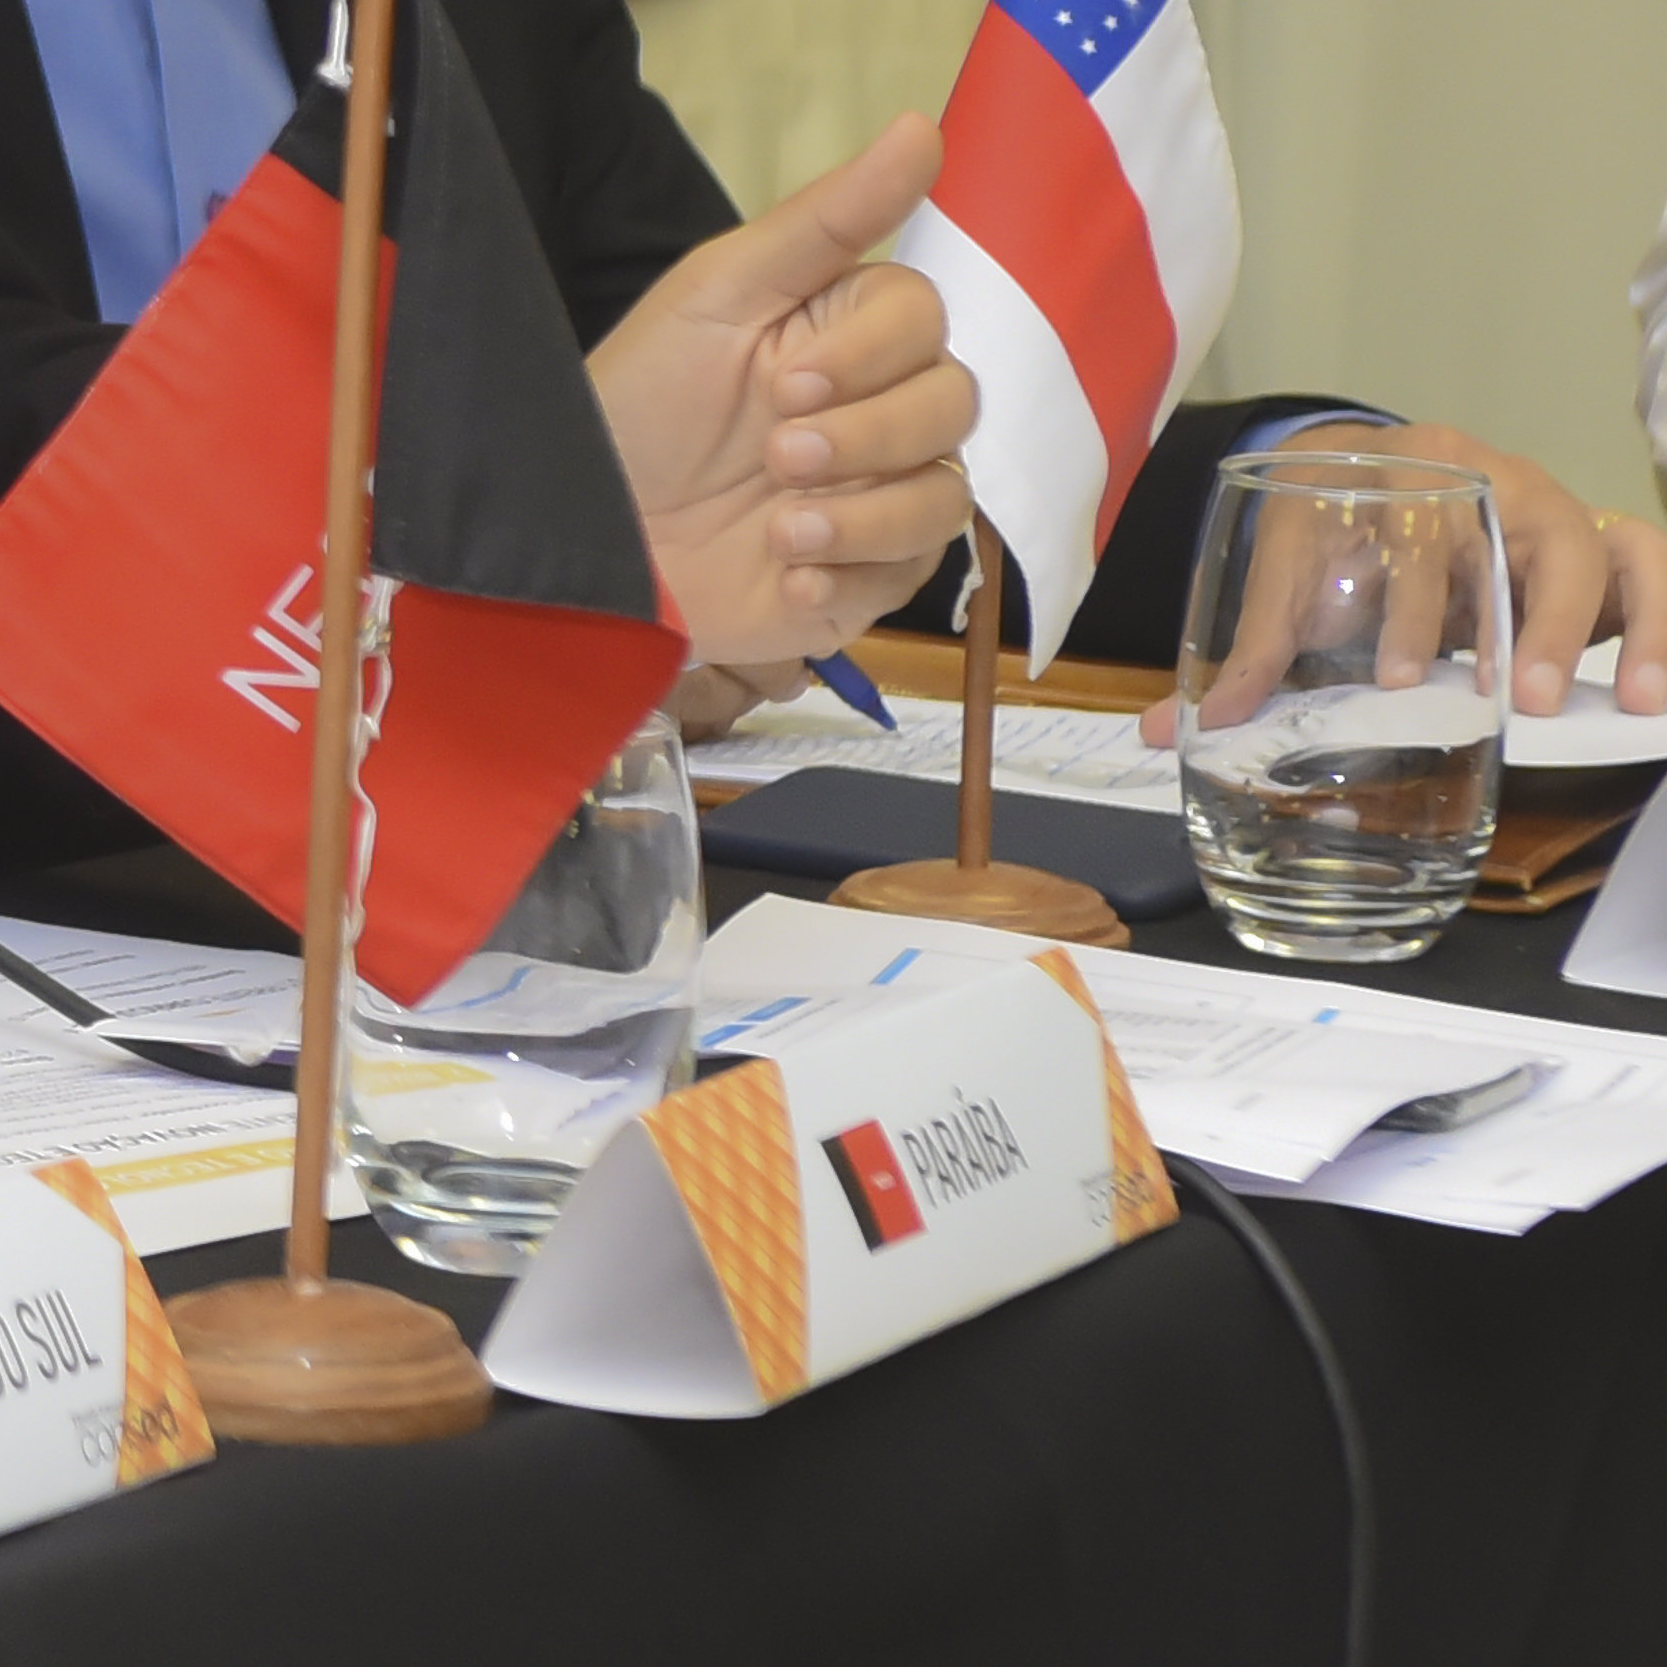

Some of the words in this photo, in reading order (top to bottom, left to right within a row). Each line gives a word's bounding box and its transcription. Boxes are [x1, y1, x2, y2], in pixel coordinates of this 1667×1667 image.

[221, 534, 328, 734] NE
[900, 1084, 1030, 1210] PARAÍBA
[14, 1289, 103, 1380] SUL
